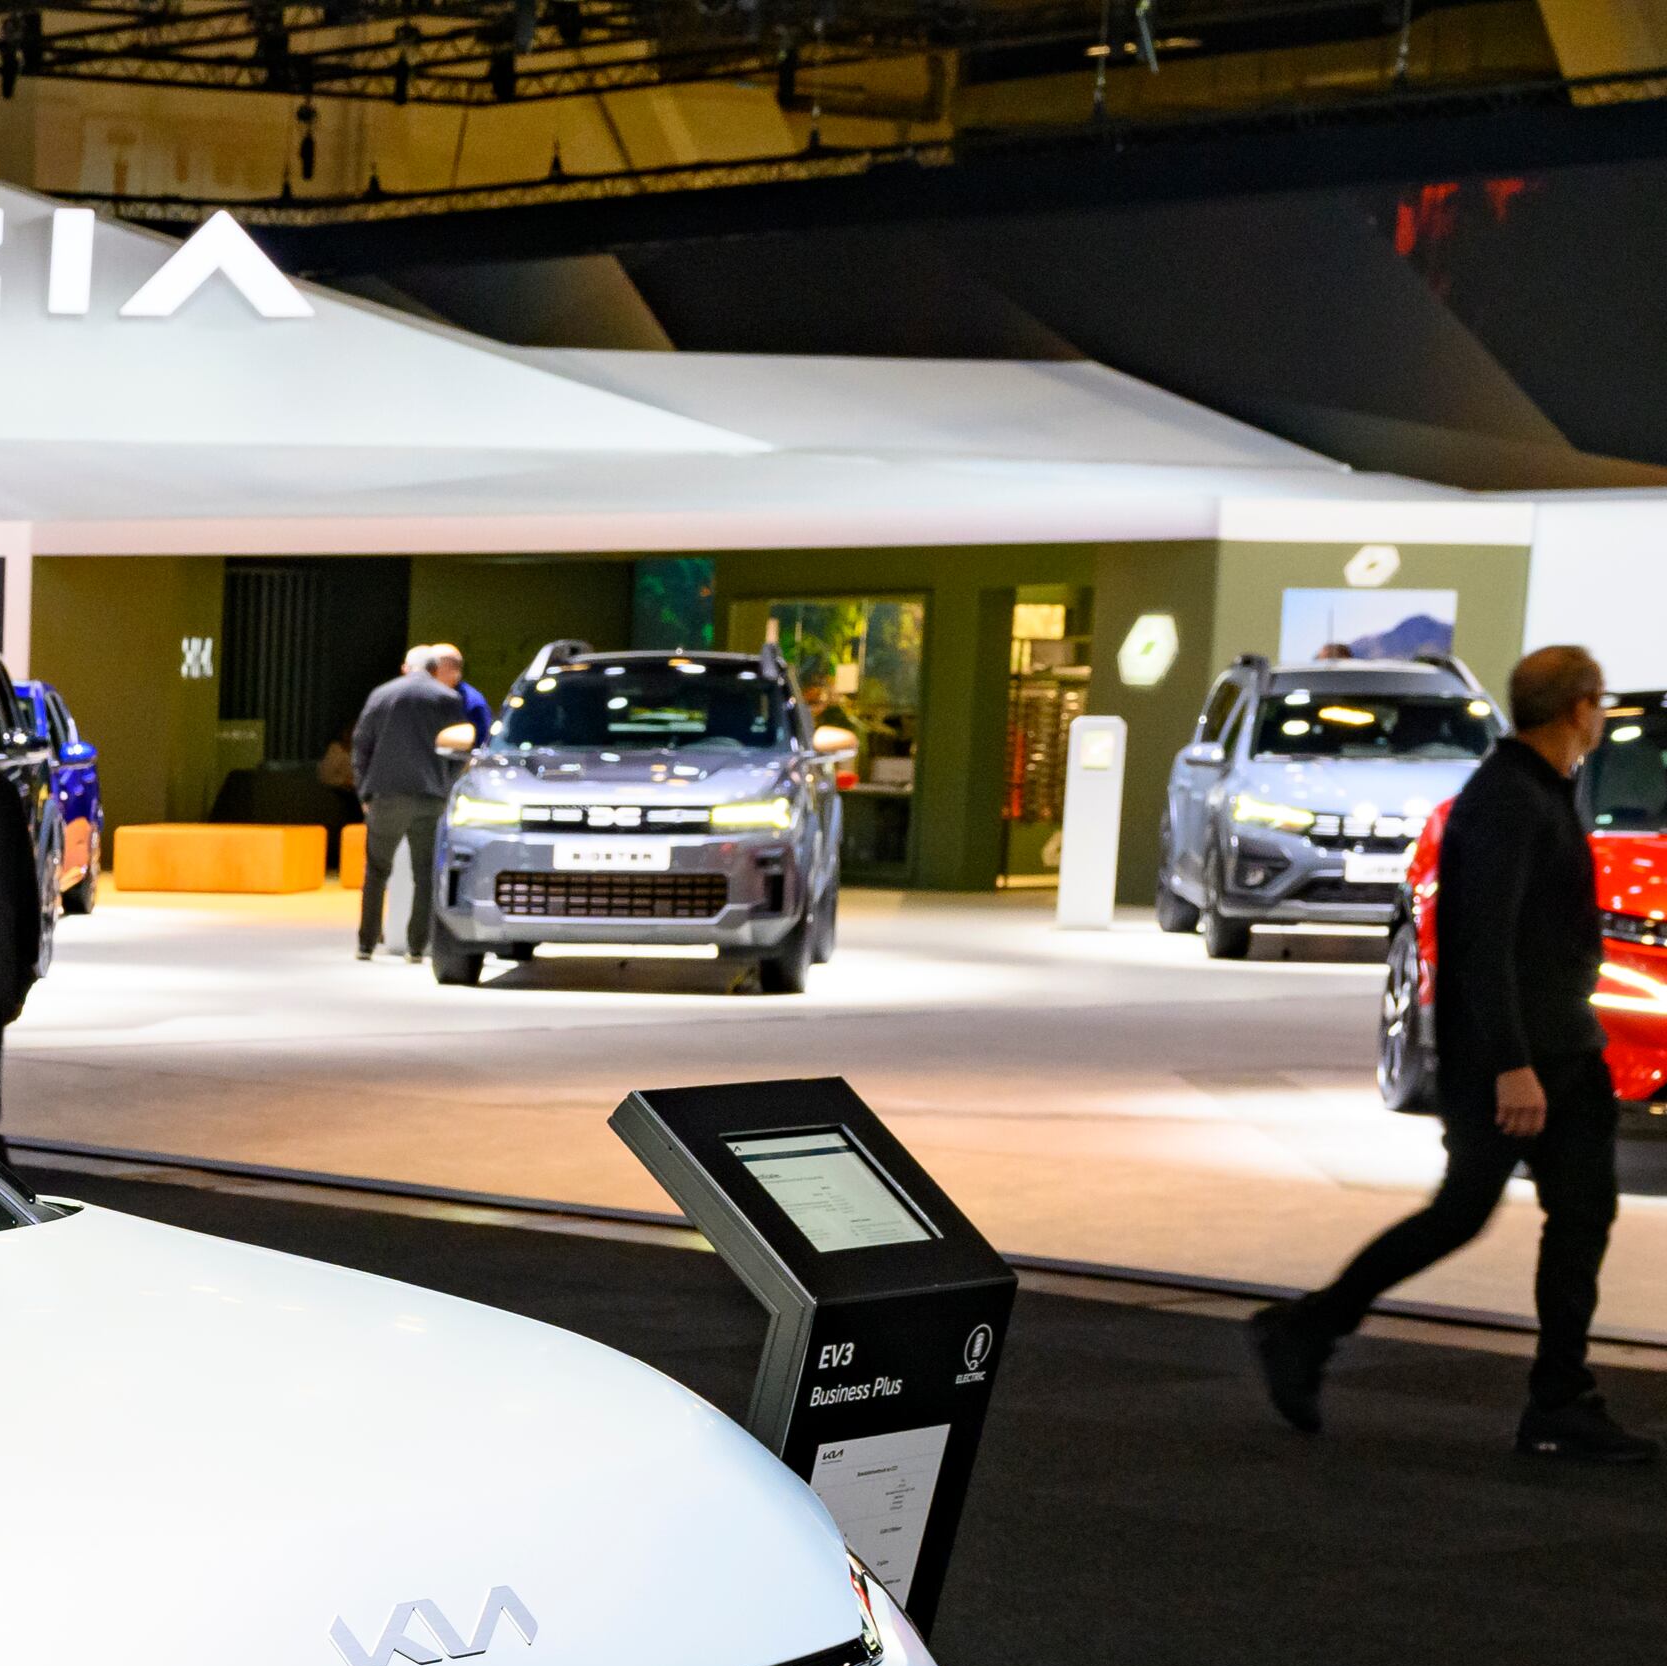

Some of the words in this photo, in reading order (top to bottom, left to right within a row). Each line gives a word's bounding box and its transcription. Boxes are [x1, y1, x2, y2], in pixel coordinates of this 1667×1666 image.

[818, 1342, 855, 1370] EV3
[809, 1384, 871, 1408] Business
[872, 1375, 903, 1399] Plus
[954, 1371, 987, 1385] ELECTRIC
